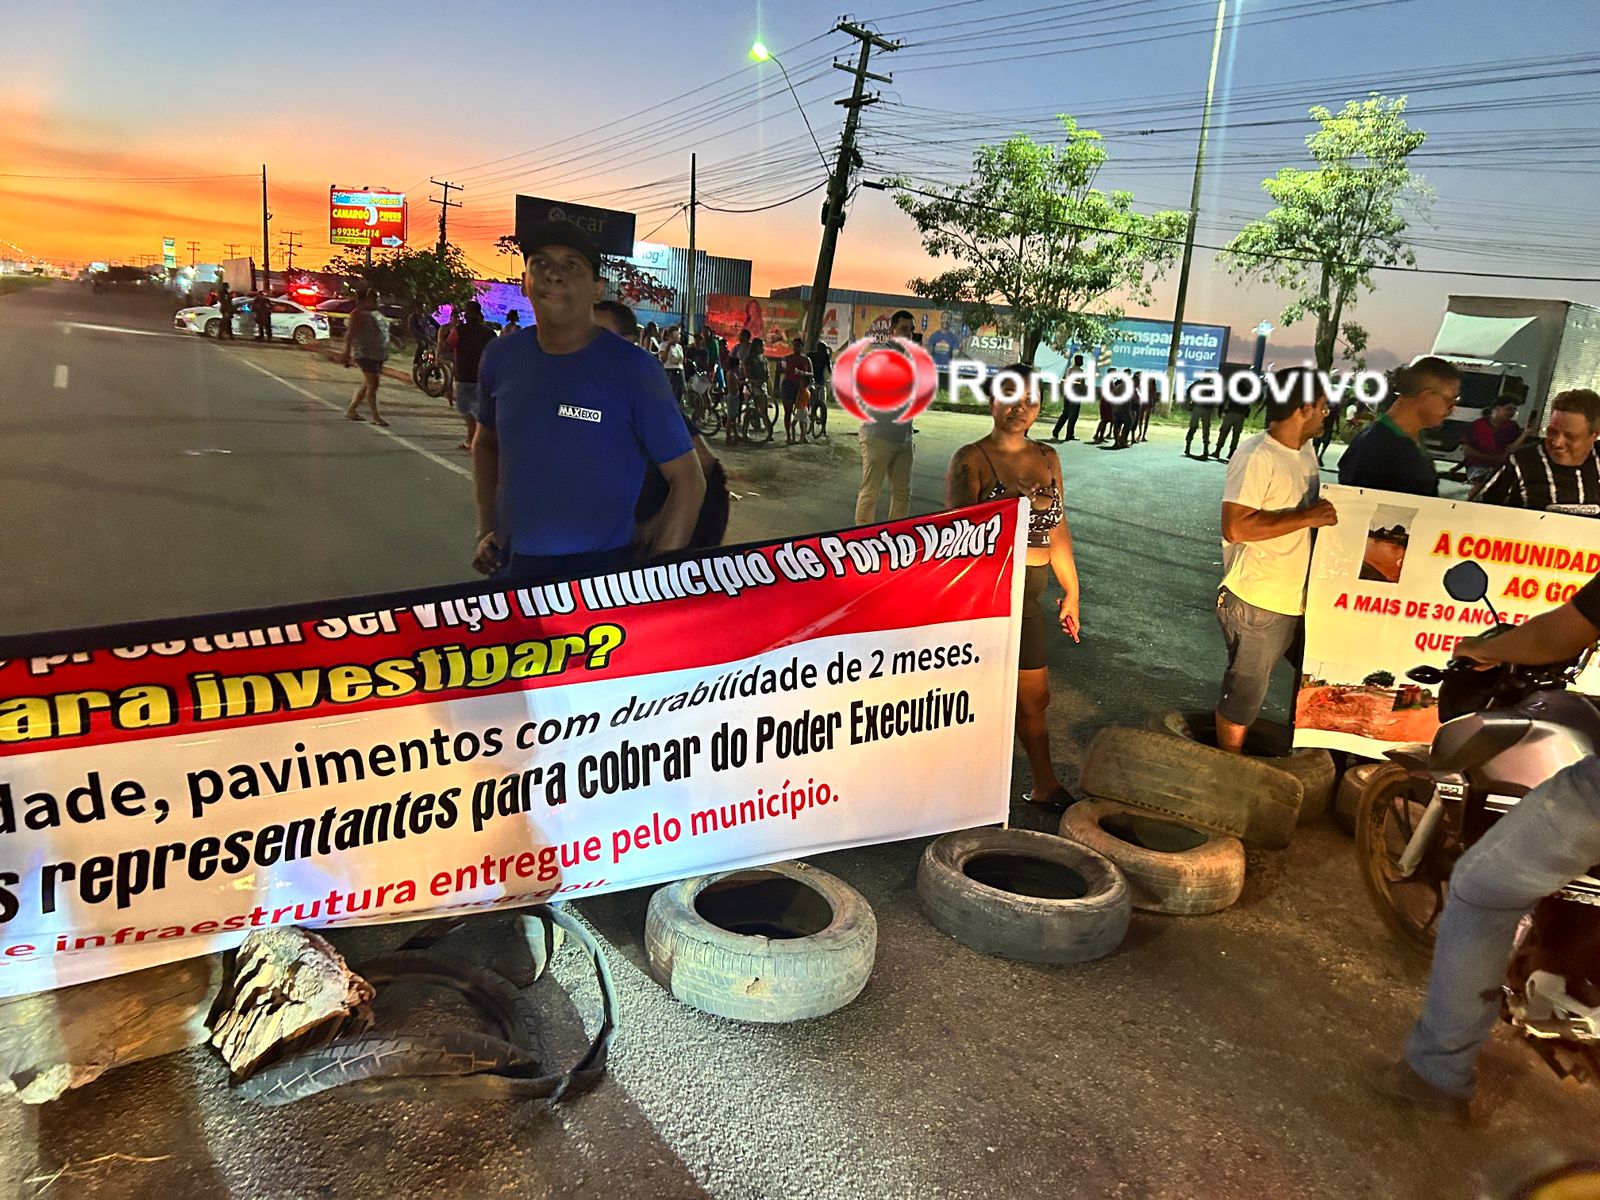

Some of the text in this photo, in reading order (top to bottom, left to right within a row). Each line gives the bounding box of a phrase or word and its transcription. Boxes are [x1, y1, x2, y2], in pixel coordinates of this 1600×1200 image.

[332, 208, 370, 219] CAMARGO
[1132, 345, 1183, 358] primeio
[1184, 348, 1217, 361] lugar
[775, 542, 825, 581] de
[821, 531, 912, 576] Porto
[914, 515, 1001, 562] Velho?
[1433, 533, 1451, 556] A
[1334, 593, 1348, 609] A
[1354, 595, 1402, 615] MAIS
[1405, 601, 1430, 619] DE
[1432, 604, 1455, 621] 30
[1458, 607, 1508, 625] ANOS
[1503, 577, 1540, 599] AO
[194, 624, 623, 719] investigar?
[187, 727, 502, 818] pavimentos
[515, 712, 601, 751] com
[610, 656, 818, 729] durabilidade
[826, 651, 862, 686] de
[869, 650, 884, 679] 2
[891, 642, 980, 676] meses.
[41, 785, 460, 915] representantes
[472, 760, 567, 832] para
[578, 735, 700, 800] cobrar
[711, 722, 748, 773] do
[756, 710, 842, 764] Poder
[850, 687, 975, 746] Executivo.
[55, 879, 416, 952] infraestrutura
[430, 836, 601, 896] entregue
[612, 812, 682, 863] pelo
[690, 778, 839, 837] município.
